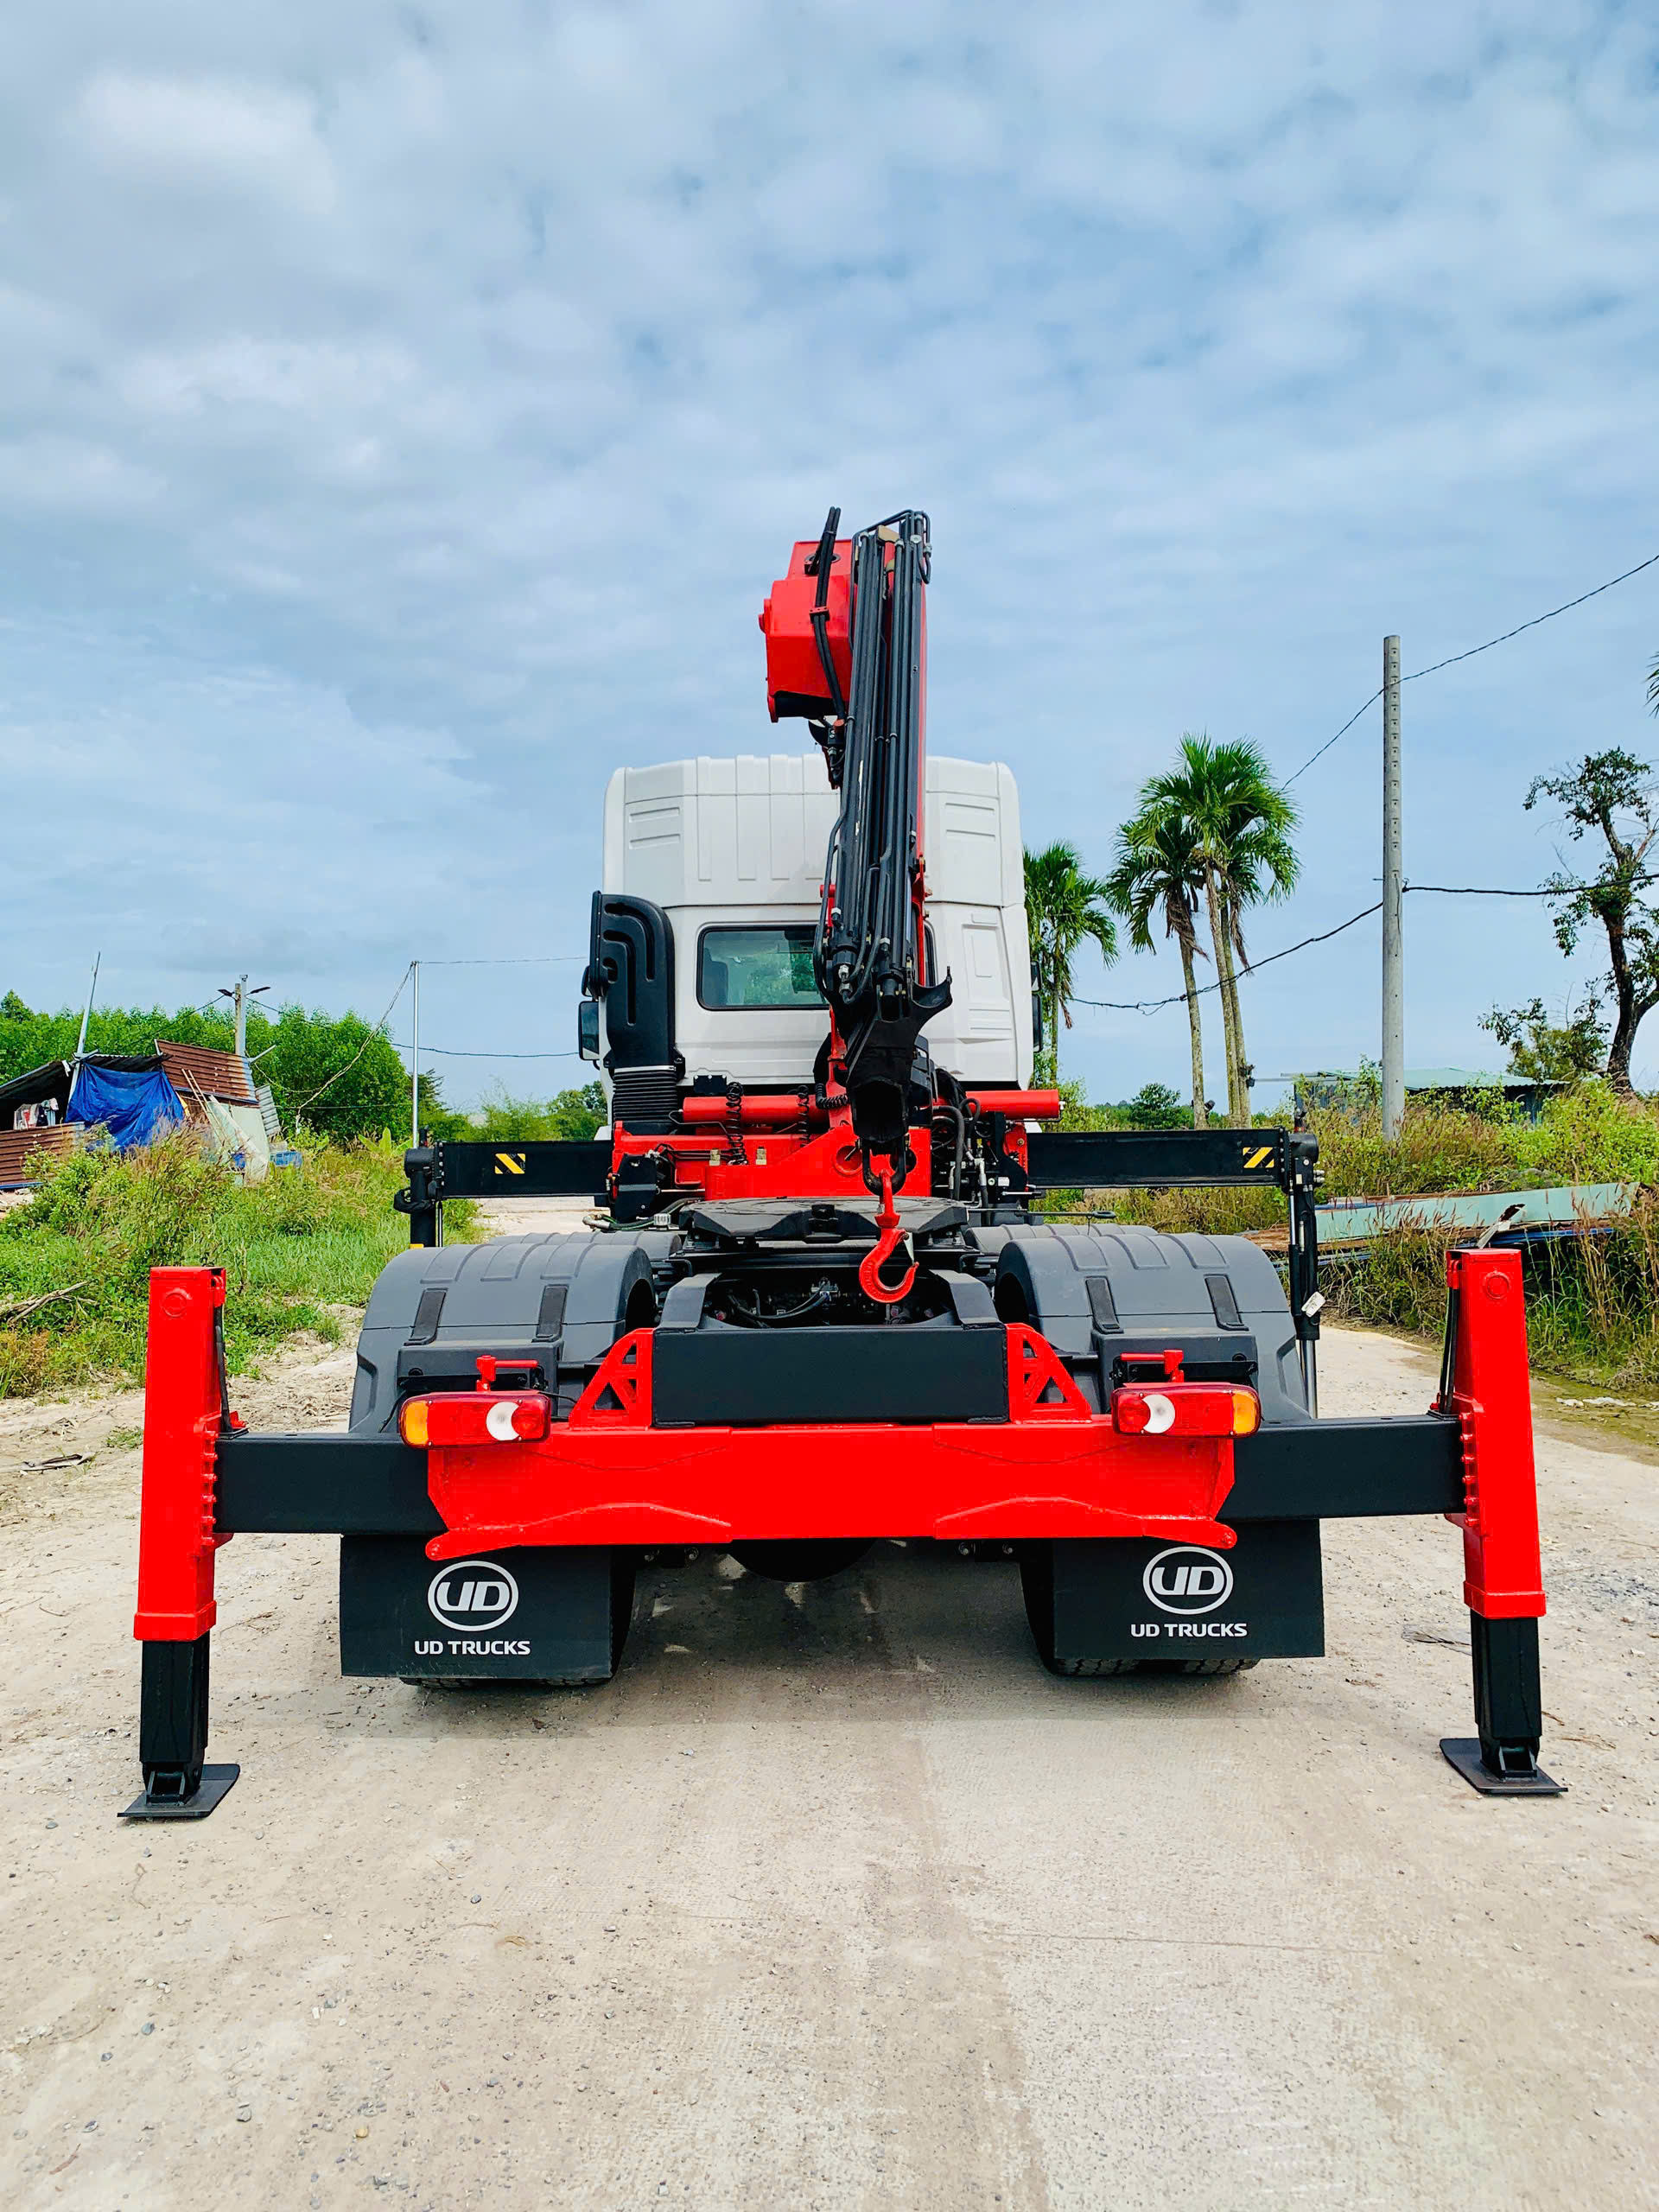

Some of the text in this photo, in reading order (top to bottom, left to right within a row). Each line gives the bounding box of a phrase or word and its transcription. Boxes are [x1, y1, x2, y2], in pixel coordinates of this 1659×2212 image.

[1152, 1566, 1225, 1596] UD
[435, 1581, 510, 1611] UD
[1130, 1623, 1247, 1637] UD TRUCKS
[414, 1640, 531, 1656] UD TRUCKS
